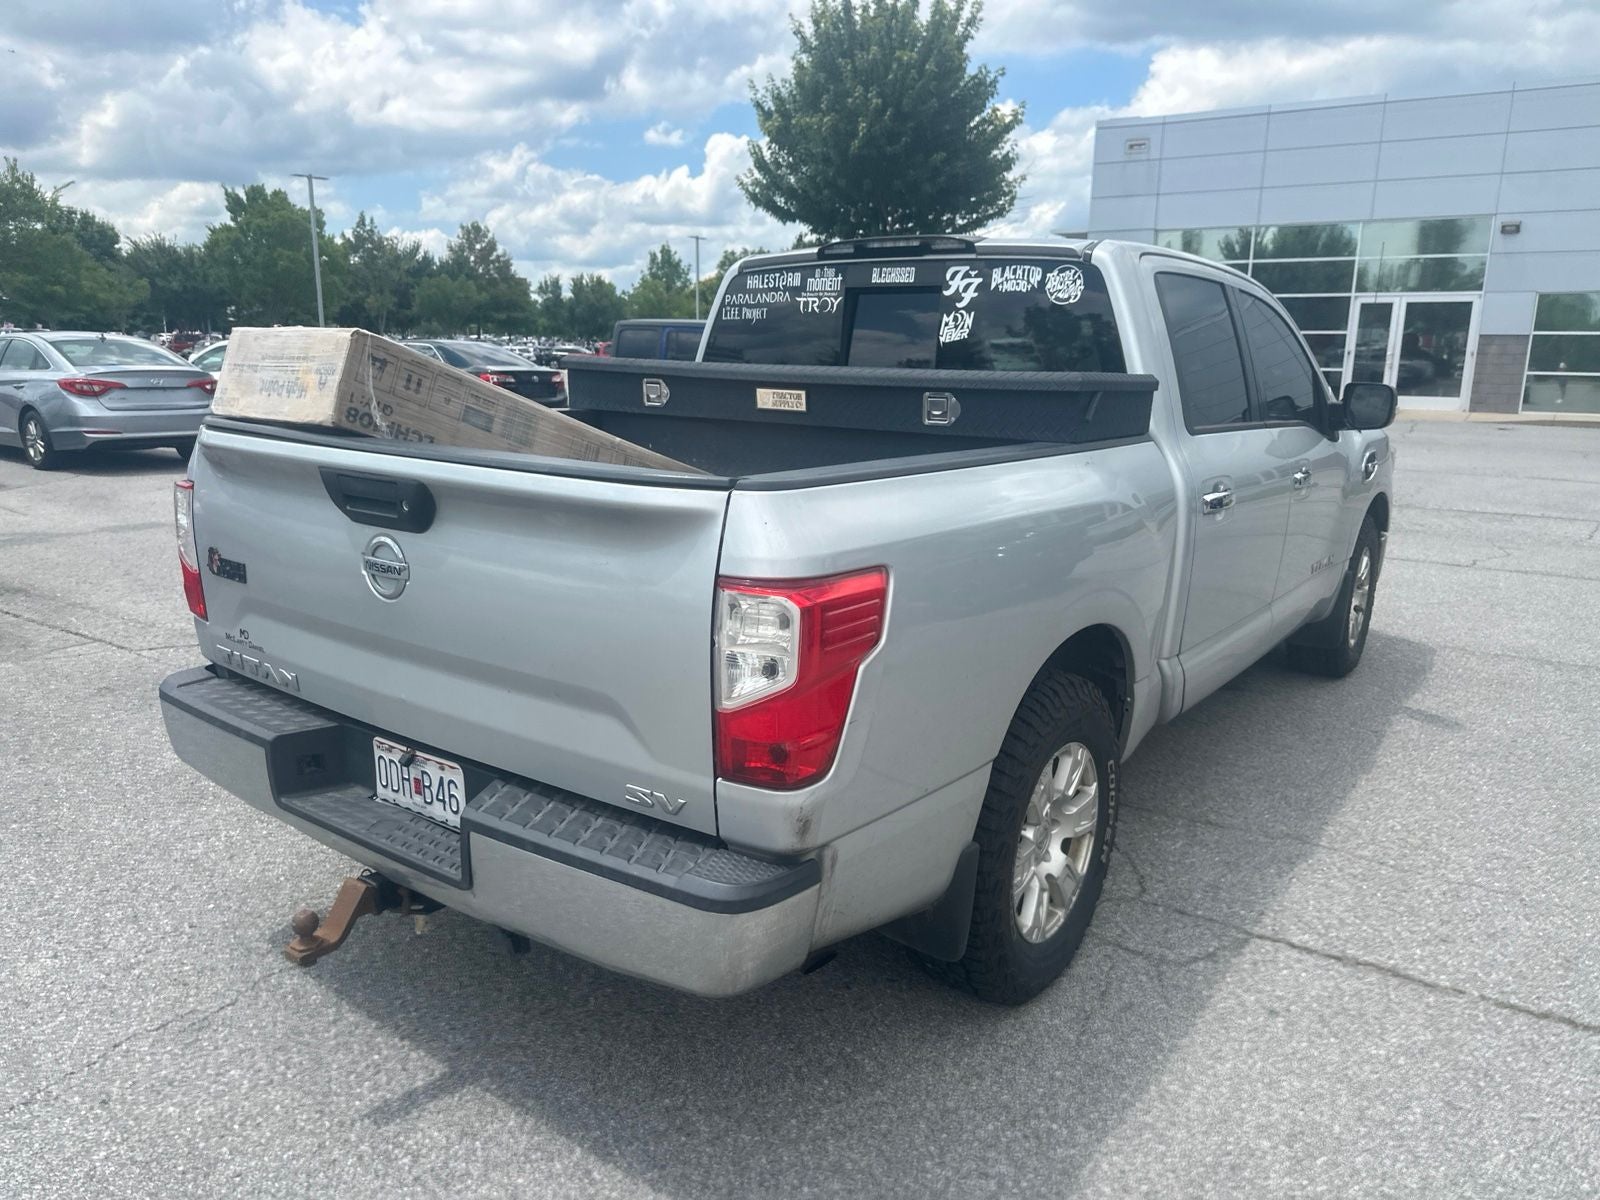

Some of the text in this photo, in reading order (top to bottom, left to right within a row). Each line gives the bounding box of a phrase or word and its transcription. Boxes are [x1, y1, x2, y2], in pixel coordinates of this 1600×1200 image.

[746, 270, 801, 289] HALESTORM
[990, 264, 1042, 291] BLACKTOP
[1002, 279, 1028, 293] MOJO
[725, 291, 791, 305] PARALANDRA
[365, 559, 402, 576] NISSAN
[215, 643, 301, 693] TITAN
[420, 769, 460, 815] B46
[624, 783, 688, 816] SV
